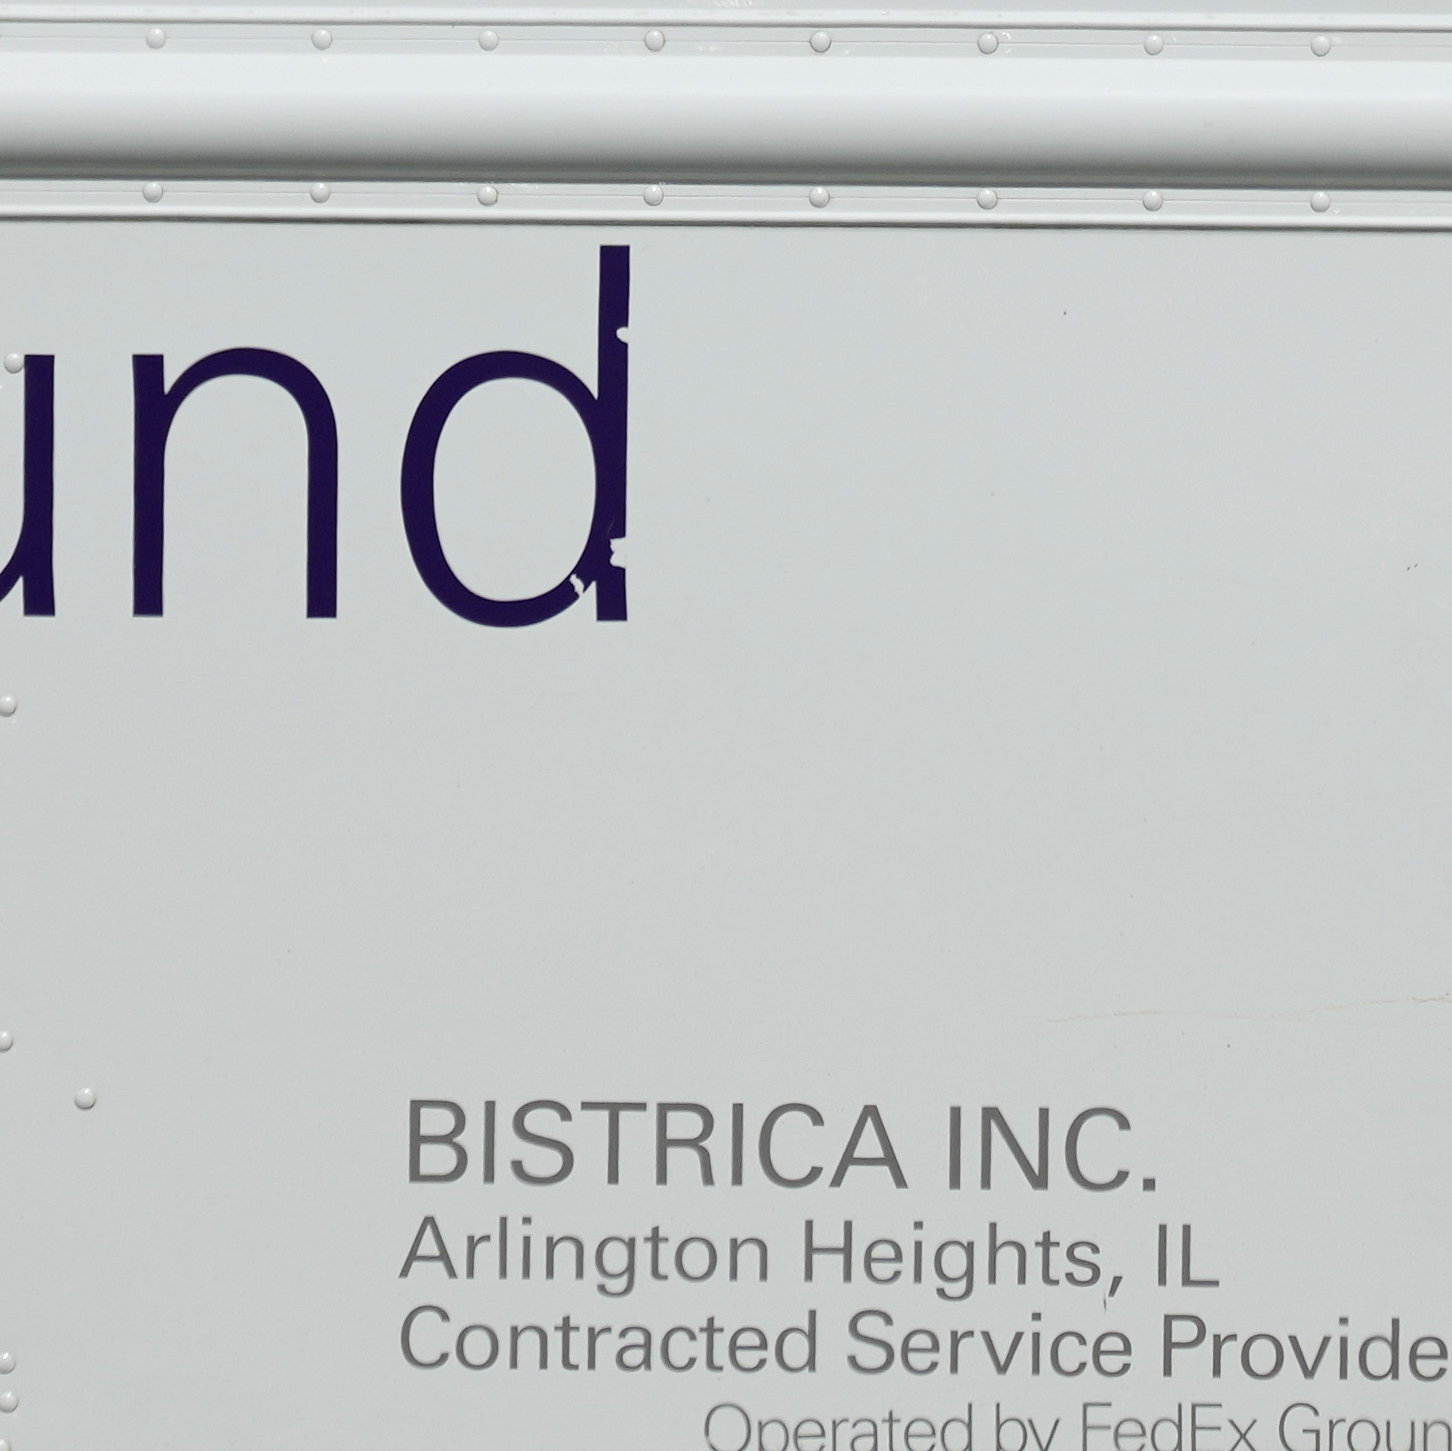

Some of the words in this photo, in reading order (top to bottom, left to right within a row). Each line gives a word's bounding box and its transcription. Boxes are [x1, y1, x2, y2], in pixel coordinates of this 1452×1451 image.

[408, 1099, 909, 1189] BISTRICA
[948, 1105, 1157, 1192] INC.
[398, 1215, 768, 1298] Arlington
[804, 1219, 1124, 1300] Heights,
[1157, 1223, 1220, 1288] IL
[400, 1304, 817, 1373] Contracted
[847, 1309, 1132, 1378] Service
[704, 1402, 973, 1451] Operated
[995, 1402, 1060, 1451] by
[1082, 1402, 1258, 1451] FedEx
